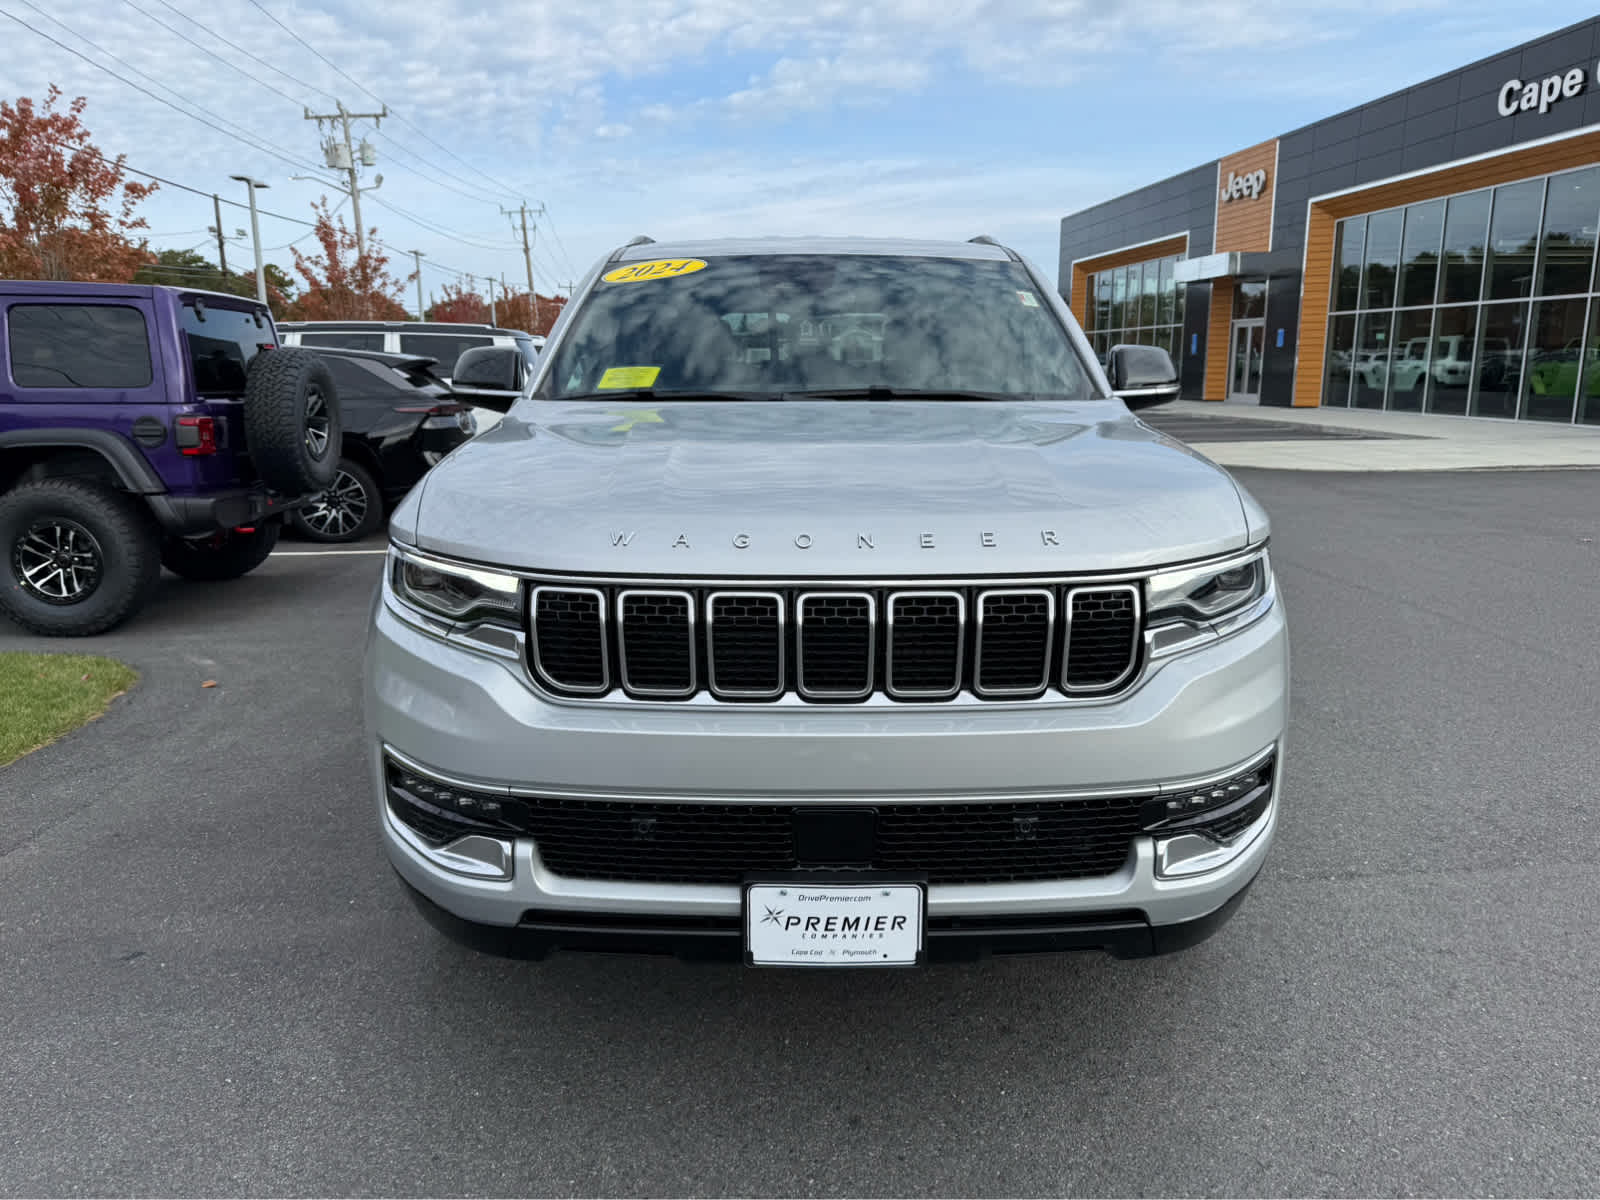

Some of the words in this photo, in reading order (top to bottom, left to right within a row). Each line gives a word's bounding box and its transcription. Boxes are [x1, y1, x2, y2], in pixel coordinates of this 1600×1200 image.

[1497, 67, 1584, 116] Cape
[1221, 169, 1266, 201] Jeep
[609, 529, 1060, 549] WAGONEER
[784, 916, 906, 931] PREMIER
